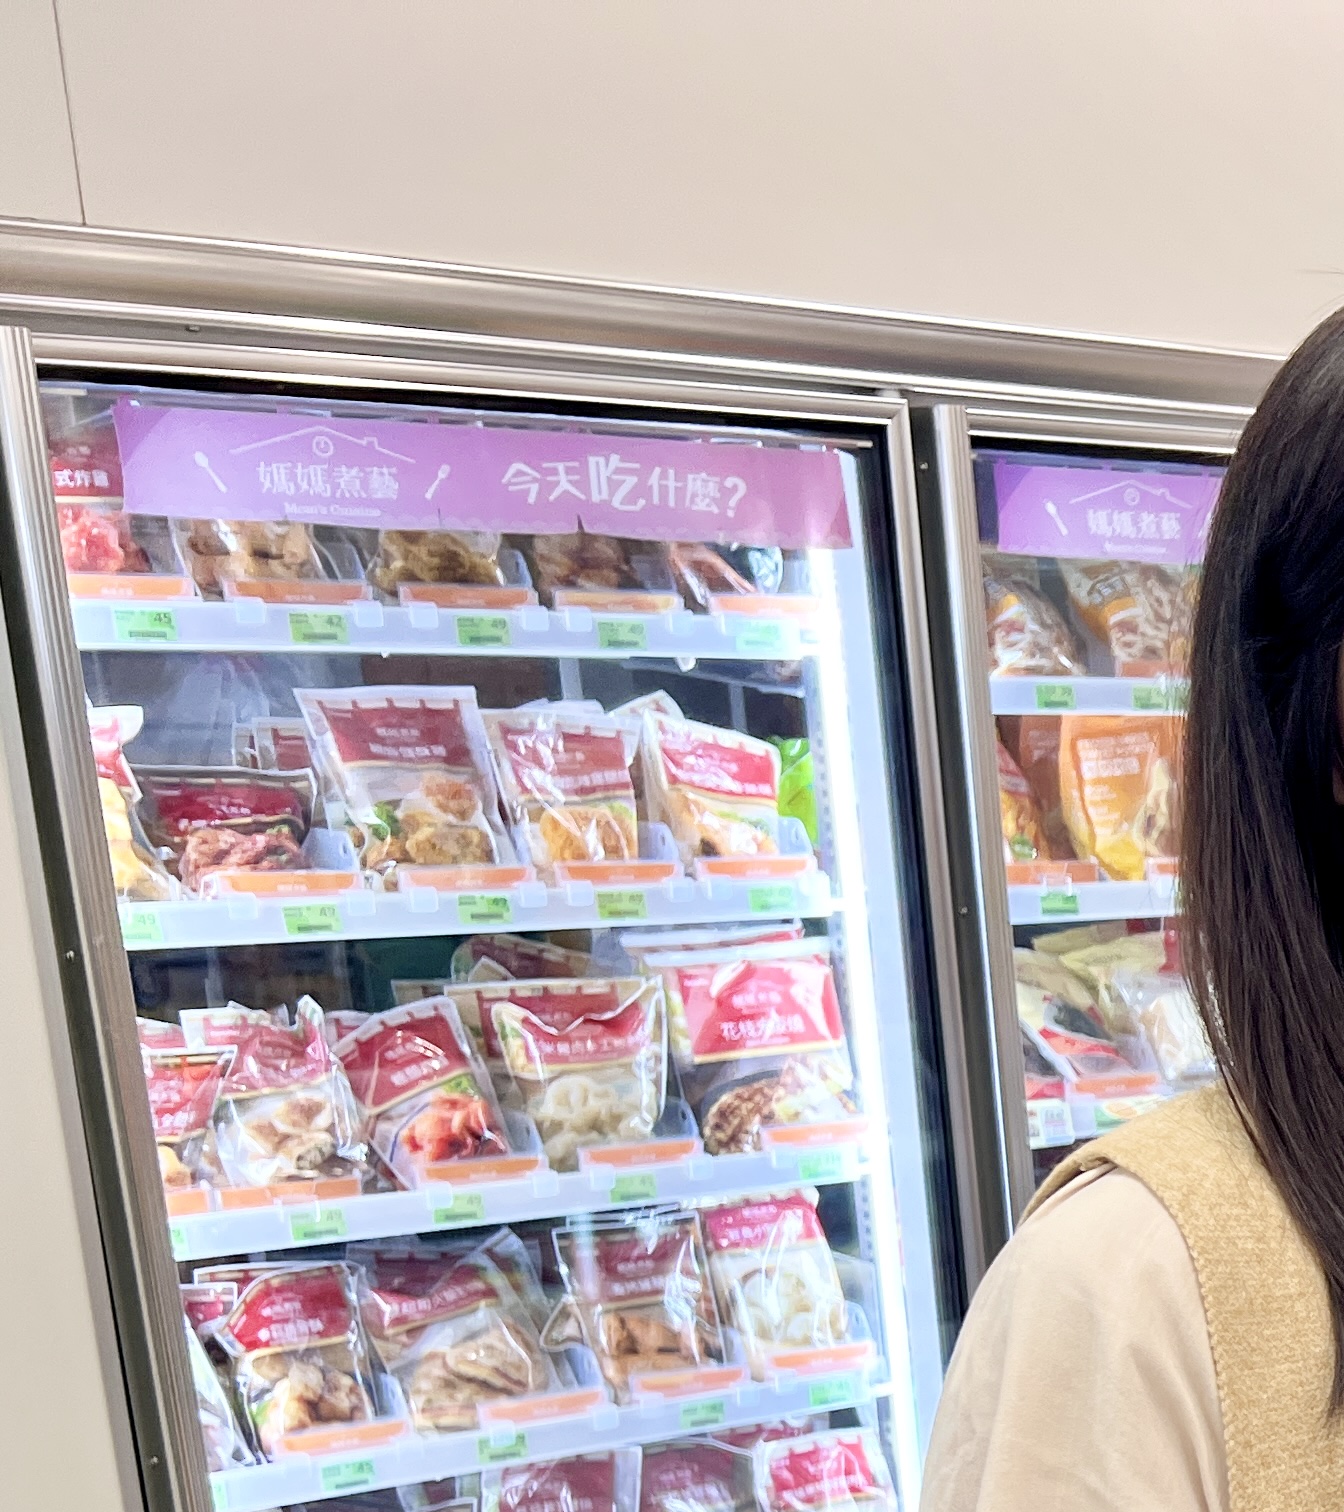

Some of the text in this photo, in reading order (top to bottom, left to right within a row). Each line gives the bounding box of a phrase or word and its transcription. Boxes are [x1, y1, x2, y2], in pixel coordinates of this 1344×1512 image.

[256, 461, 400, 500] 媽媽煮藝
[502, 453, 748, 518] 今天吃什麼?
